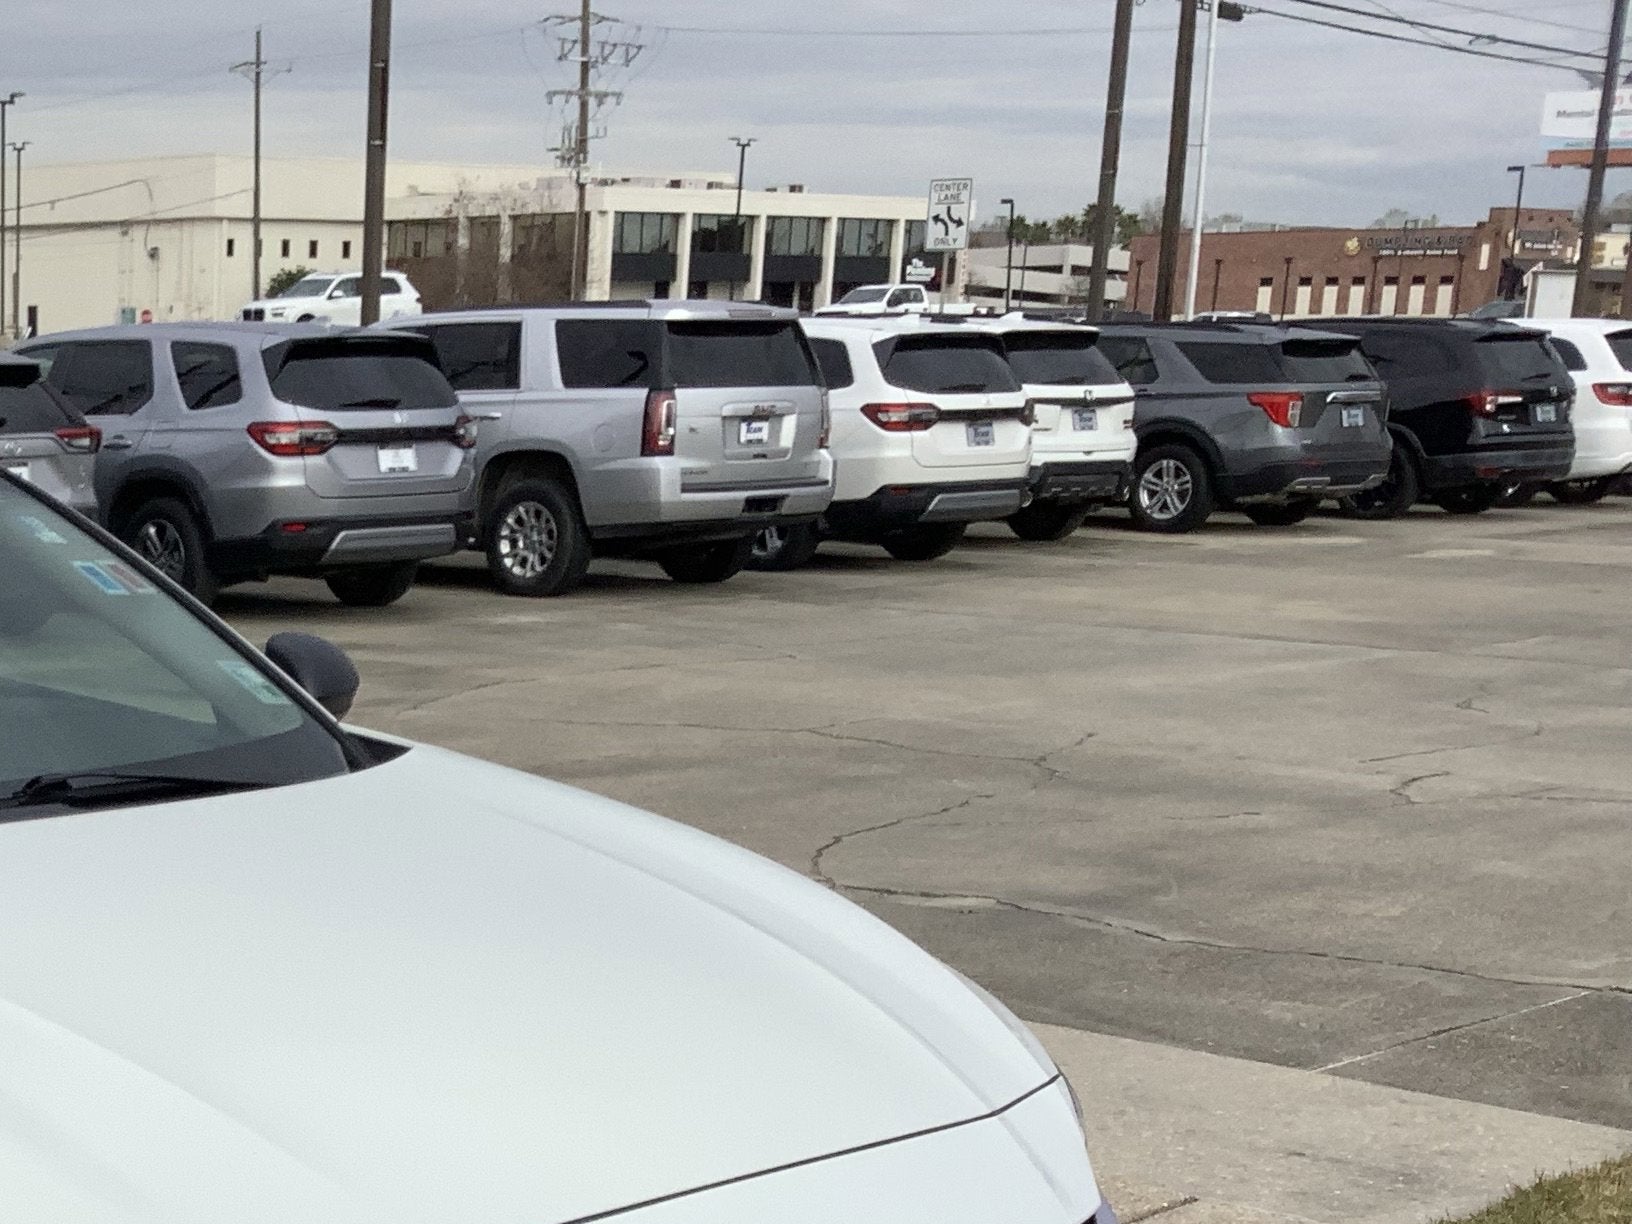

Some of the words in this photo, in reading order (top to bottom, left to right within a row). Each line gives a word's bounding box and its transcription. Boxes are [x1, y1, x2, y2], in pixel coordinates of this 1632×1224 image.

[933, 182, 969, 193] CENTER
[937, 191, 962, 203] LANE
[933, 238, 959, 247] ONLY
